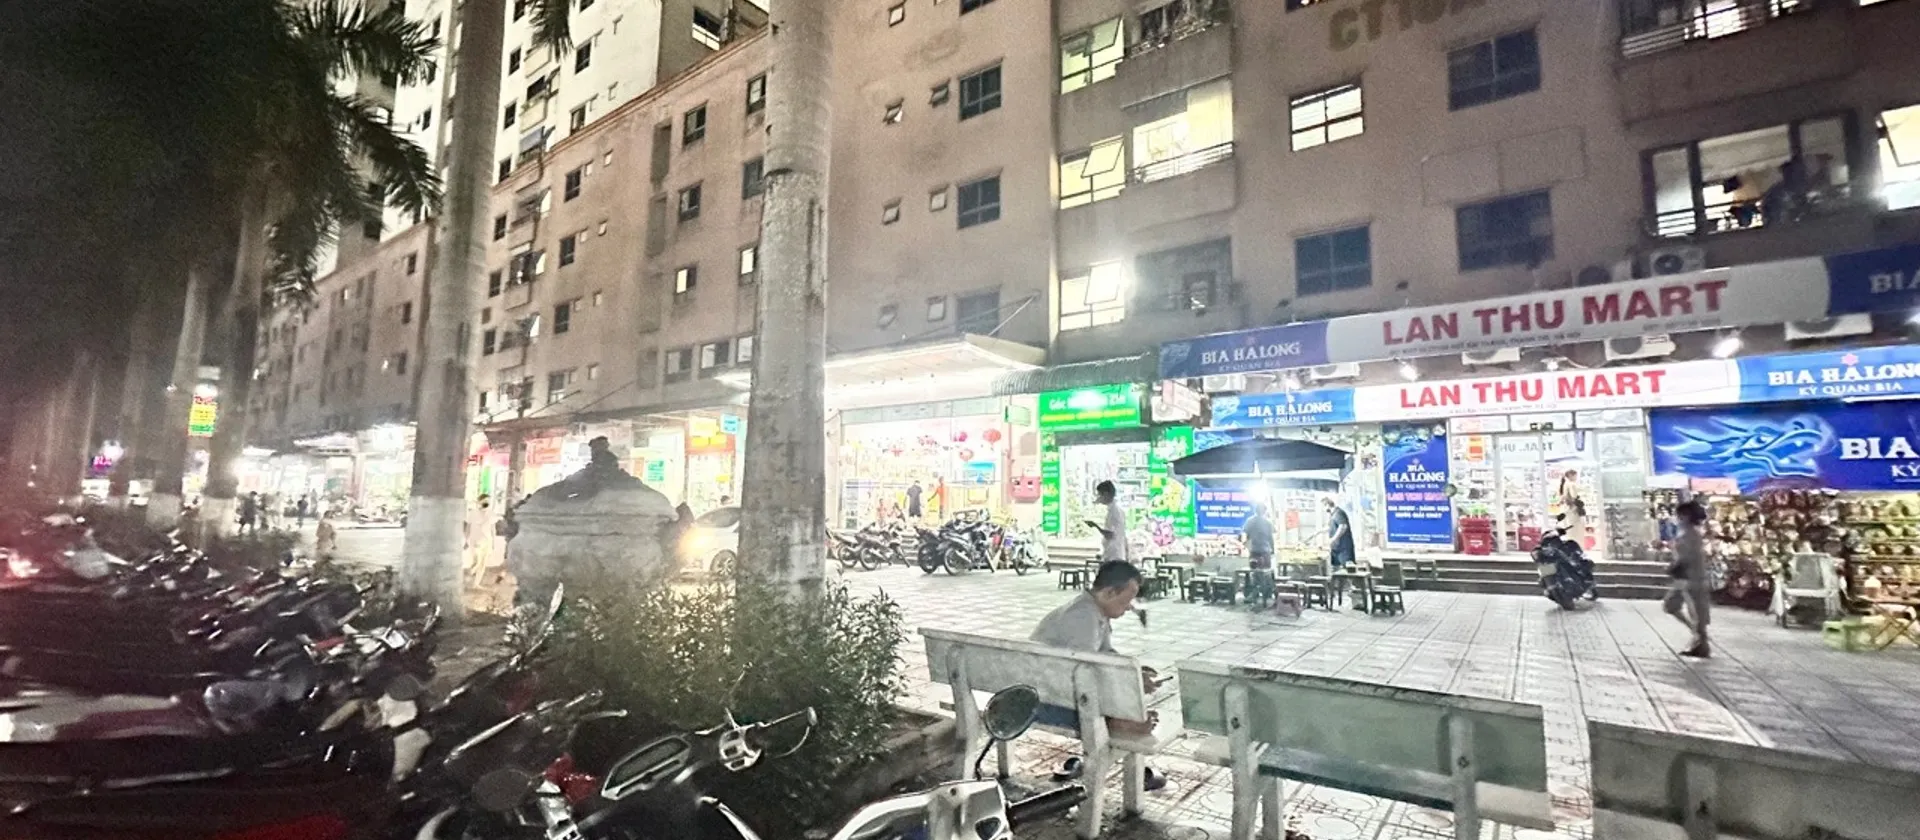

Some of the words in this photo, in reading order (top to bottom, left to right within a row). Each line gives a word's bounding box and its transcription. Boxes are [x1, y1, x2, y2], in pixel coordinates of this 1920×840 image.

[1383, 312, 1459, 345] LAN
[1473, 300, 1565, 335] THU
[1582, 280, 1728, 325] MART
[1202, 350, 1229, 365] BIA
[1233, 341, 1301, 361] HALONG
[1768, 369, 1817, 386] BIA
[1822, 362, 1920, 383] HALON
[1400, 384, 1461, 408] LAN
[1472, 379, 1543, 403] THU
[1557, 369, 1666, 399] MART
[1822, 383, 1871, 396] QUAN
[1875, 381, 1903, 392] BIA
[1247, 405, 1273, 418] BIA
[1275, 400, 1333, 415] HALONG
[1839, 436, 1920, 460] BIA
[1388, 471, 1446, 482] HALONG
[1407, 464, 1426, 472] BIA
